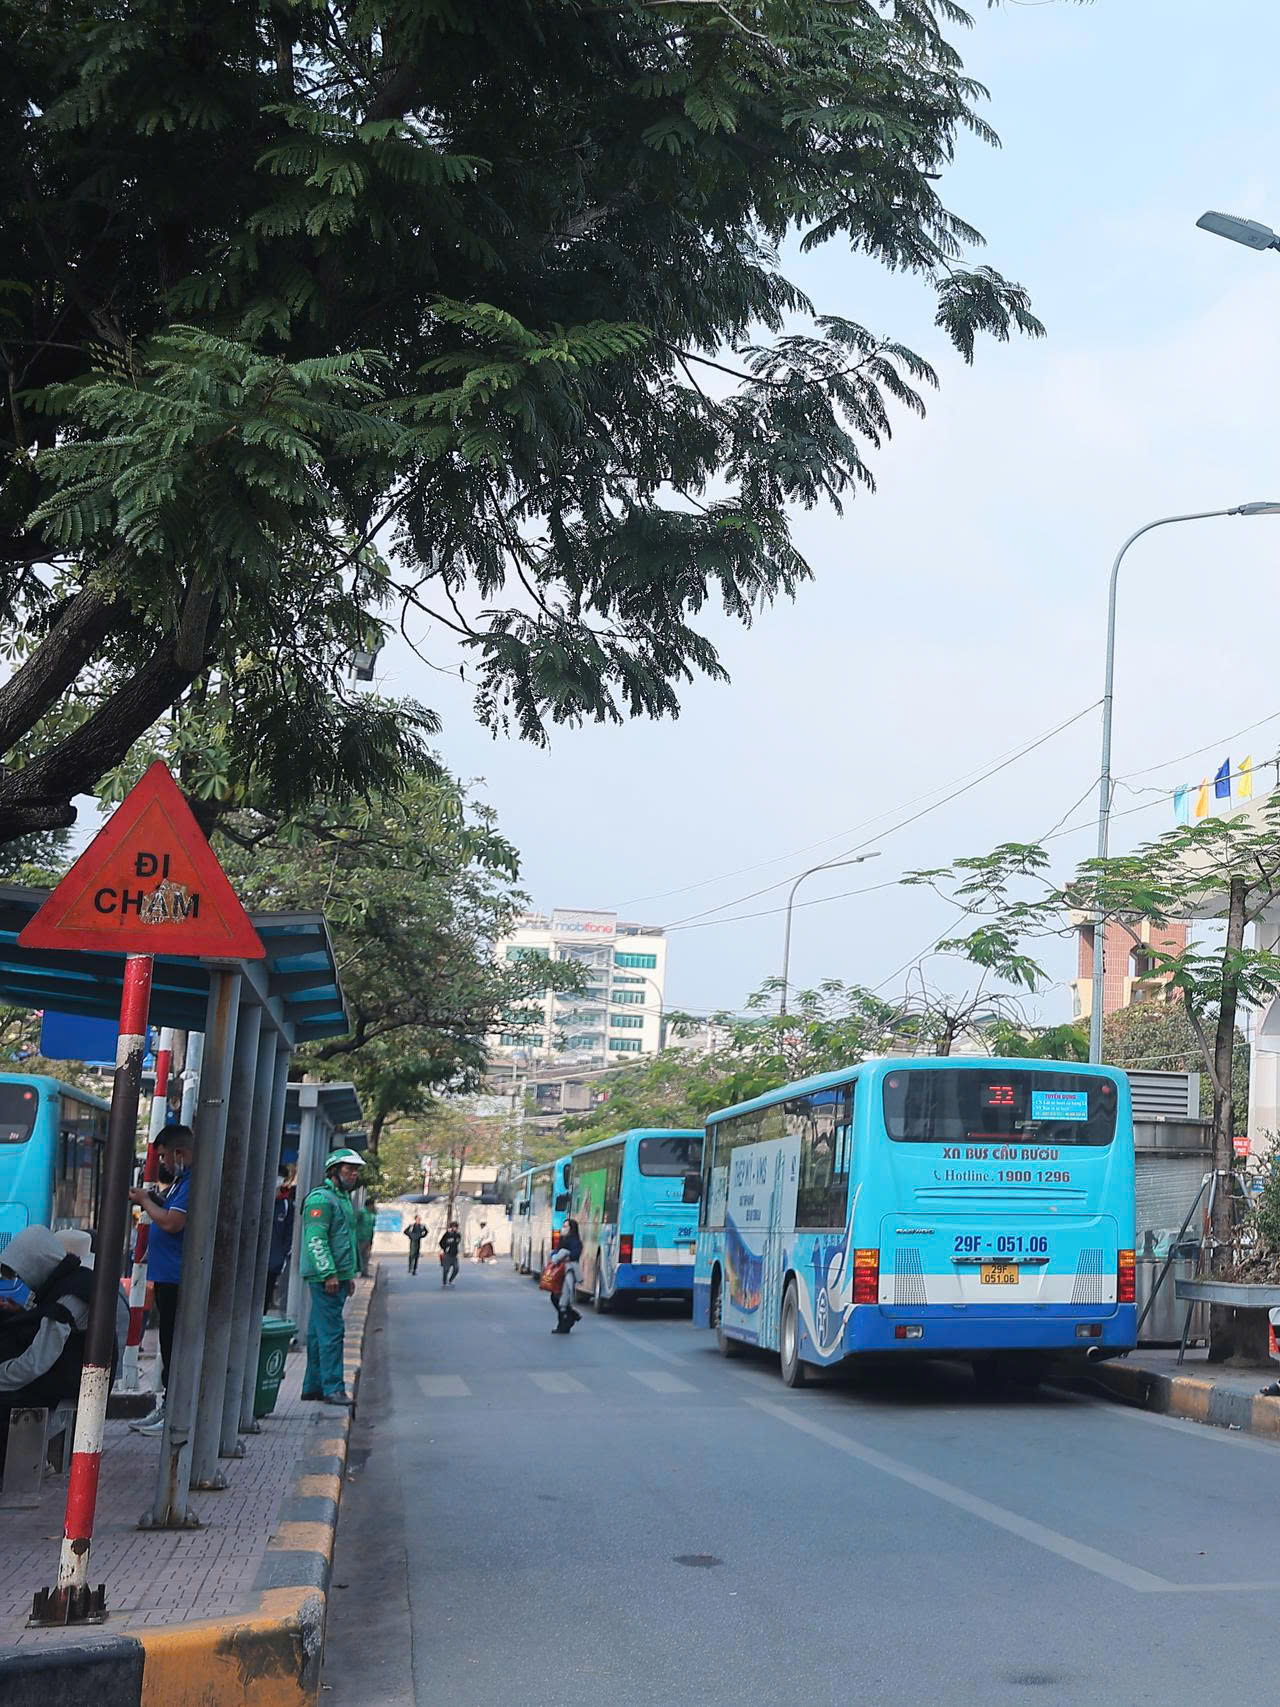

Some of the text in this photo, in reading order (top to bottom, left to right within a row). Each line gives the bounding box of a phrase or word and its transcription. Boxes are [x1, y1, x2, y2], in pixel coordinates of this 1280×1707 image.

[135, 852, 170, 879] ĐI
[966, 1147, 989, 1160] BUS
[992, 1142, 1017, 1160] CẦU
[999, 1170, 1032, 1183] 1900
[1037, 1171, 1071, 1183] 1296
[954, 1235, 982, 1253] 29F
[997, 1236, 1048, 1253] 051.06
[991, 1265, 1008, 1274] 29F
[984, 1274, 1015, 1284] 051.06
